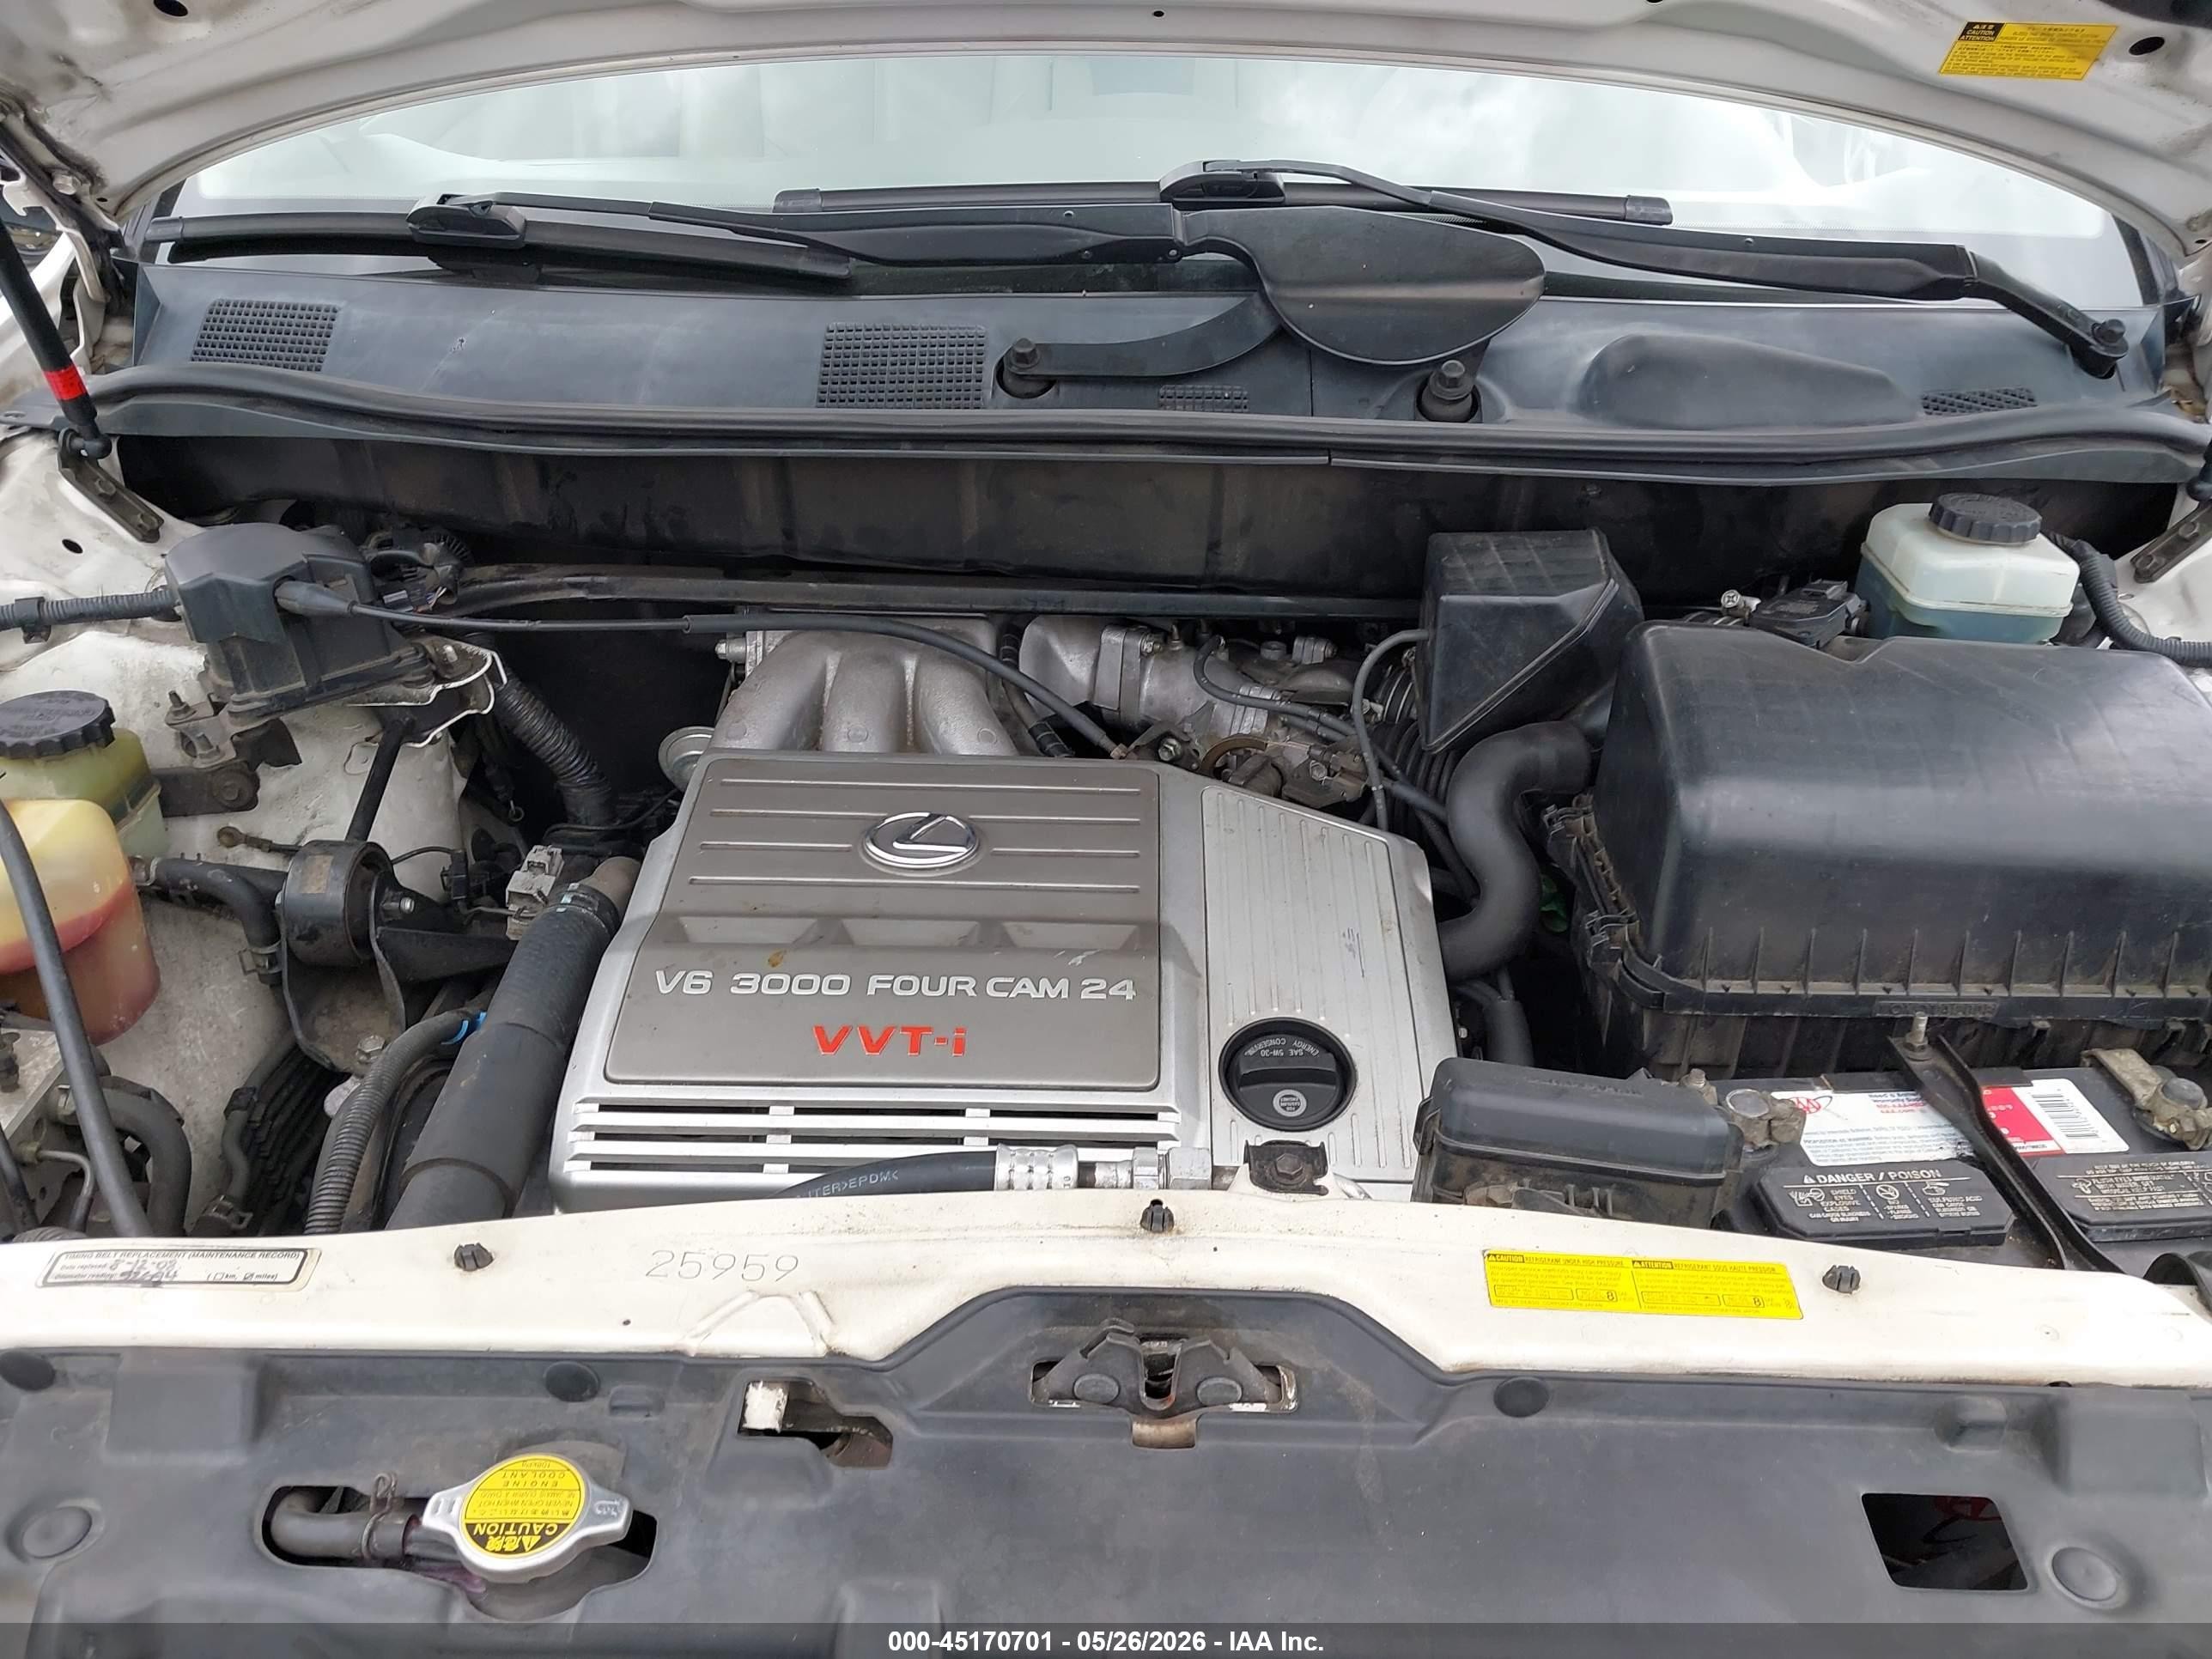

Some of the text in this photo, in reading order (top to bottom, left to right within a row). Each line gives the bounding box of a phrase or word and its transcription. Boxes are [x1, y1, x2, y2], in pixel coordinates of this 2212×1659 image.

[654, 969, 1136, 1001] V6 3000 FOUR CAM 24
[812, 1025, 967, 1057] VVT-i
[1292, 1040, 1320, 1057] ENERGY
[1816, 1173, 1875, 1184] DANGER
[1889, 1170, 1942, 1181] POISON
[187, 1251, 257, 1260] (MAINTENANCE
[258, 1251, 301, 1260] RECORD)
[646, 1249, 799, 1282] 25959
[473, 1523, 558, 1535] CAUTION
